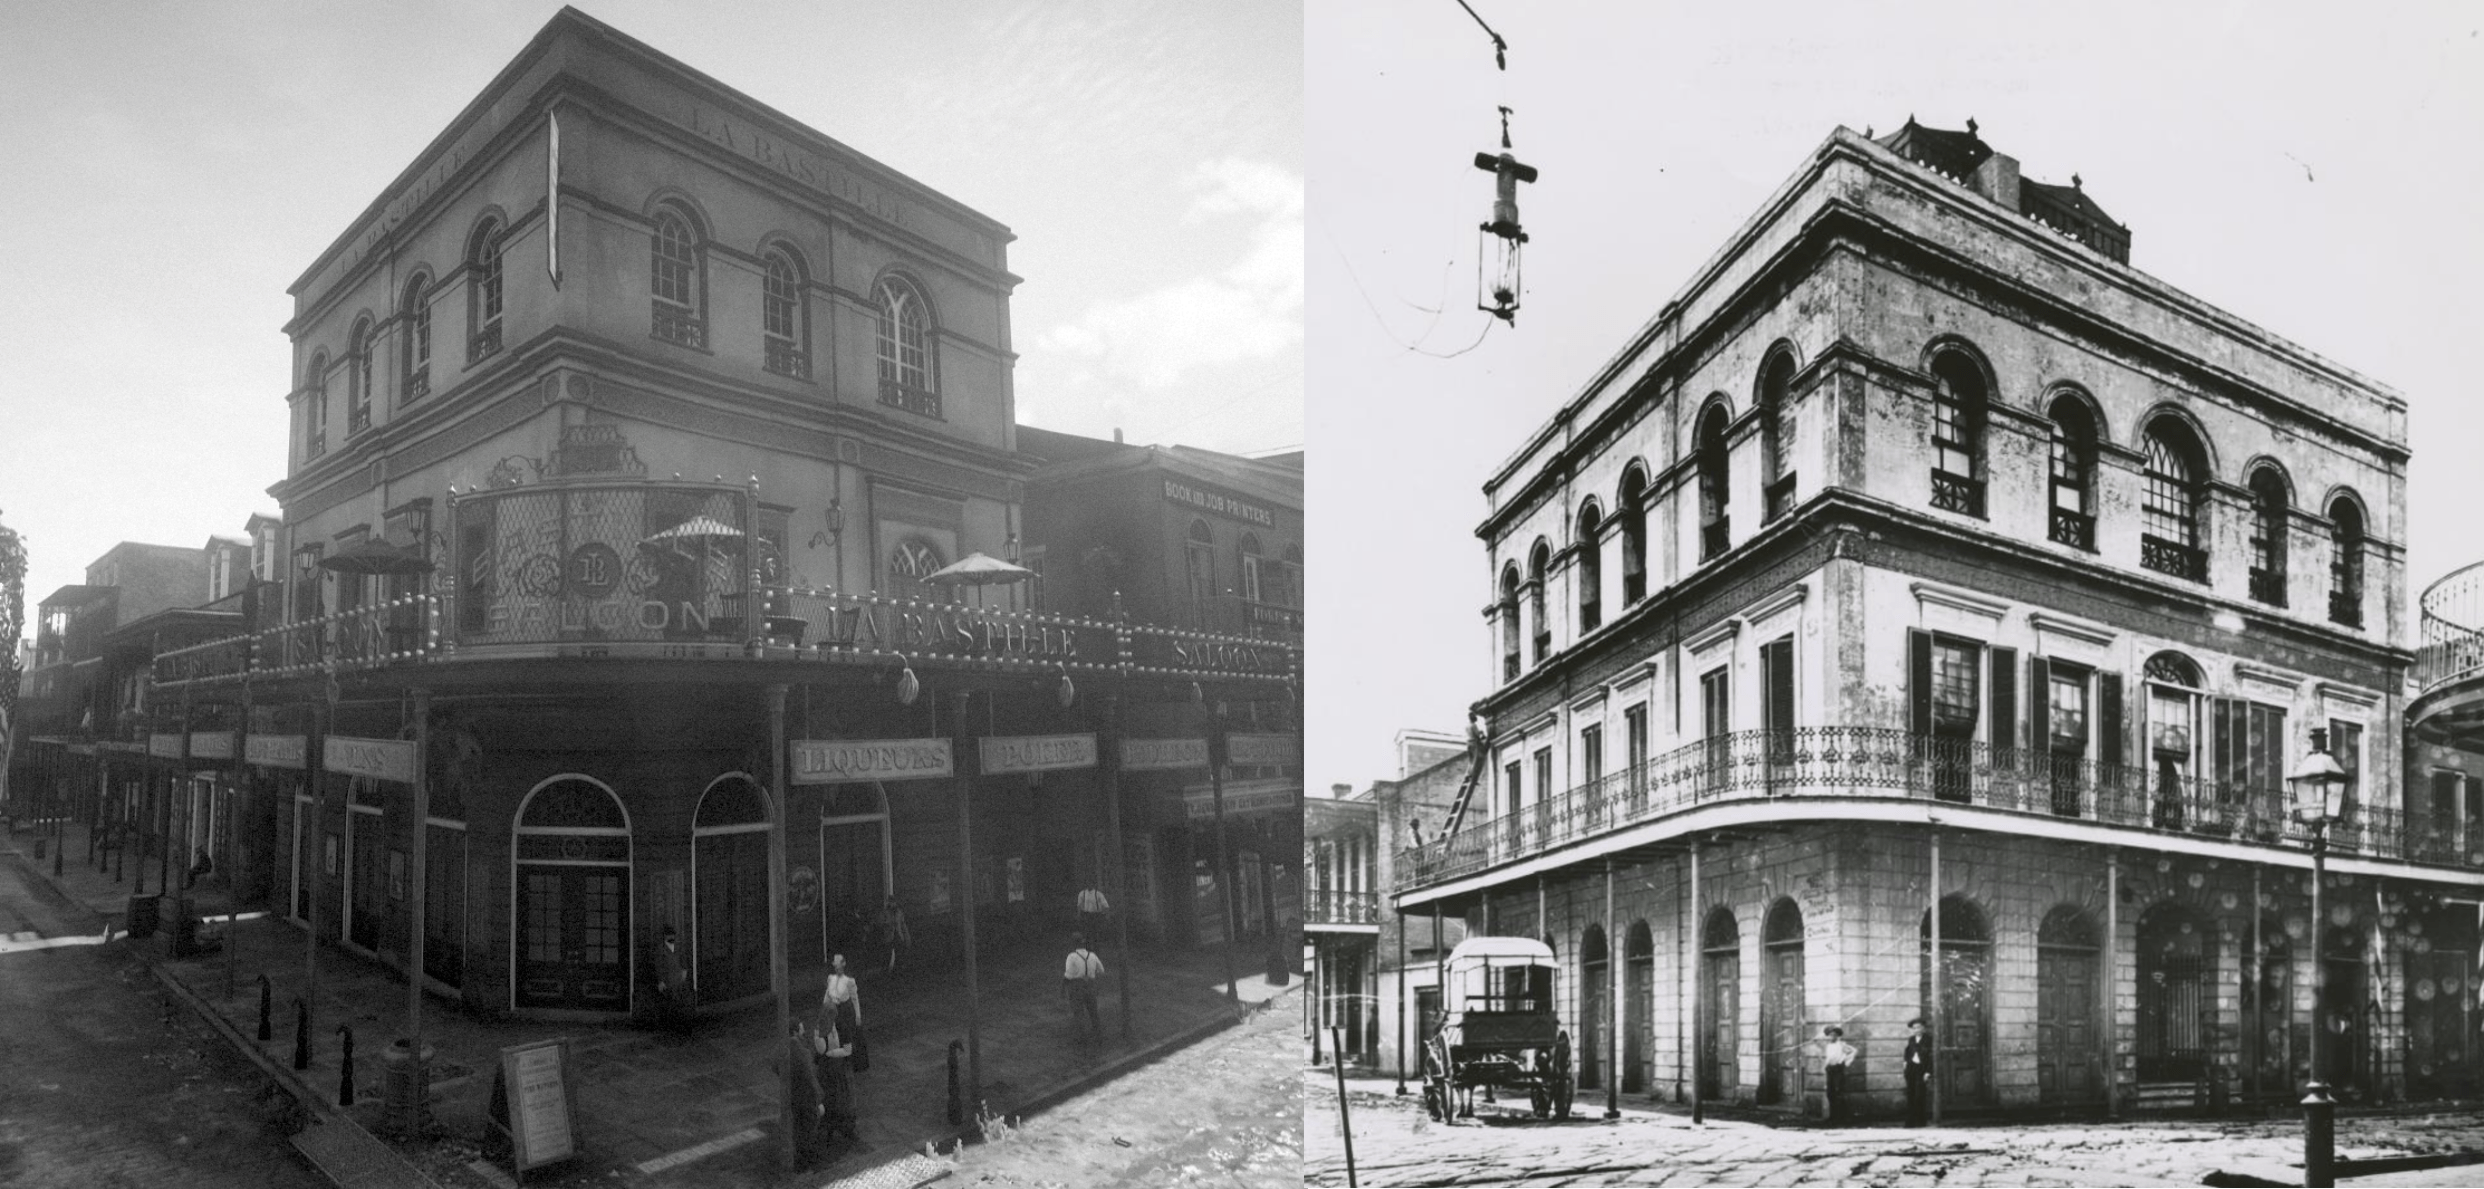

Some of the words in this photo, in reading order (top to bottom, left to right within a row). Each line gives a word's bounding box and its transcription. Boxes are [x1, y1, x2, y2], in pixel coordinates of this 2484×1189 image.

[692, 107, 735, 149] LA
[752, 134, 910, 227] BASTILLE
[1164, 480, 1192, 503] BOOK
[1206, 493, 1225, 512] JOB
[1226, 498, 1272, 526] PRINTERS
[488, 600, 711, 634] SALOON
[904, 611, 1078, 656] BASTILLE
[802, 747, 945, 778] LIQUEURS
